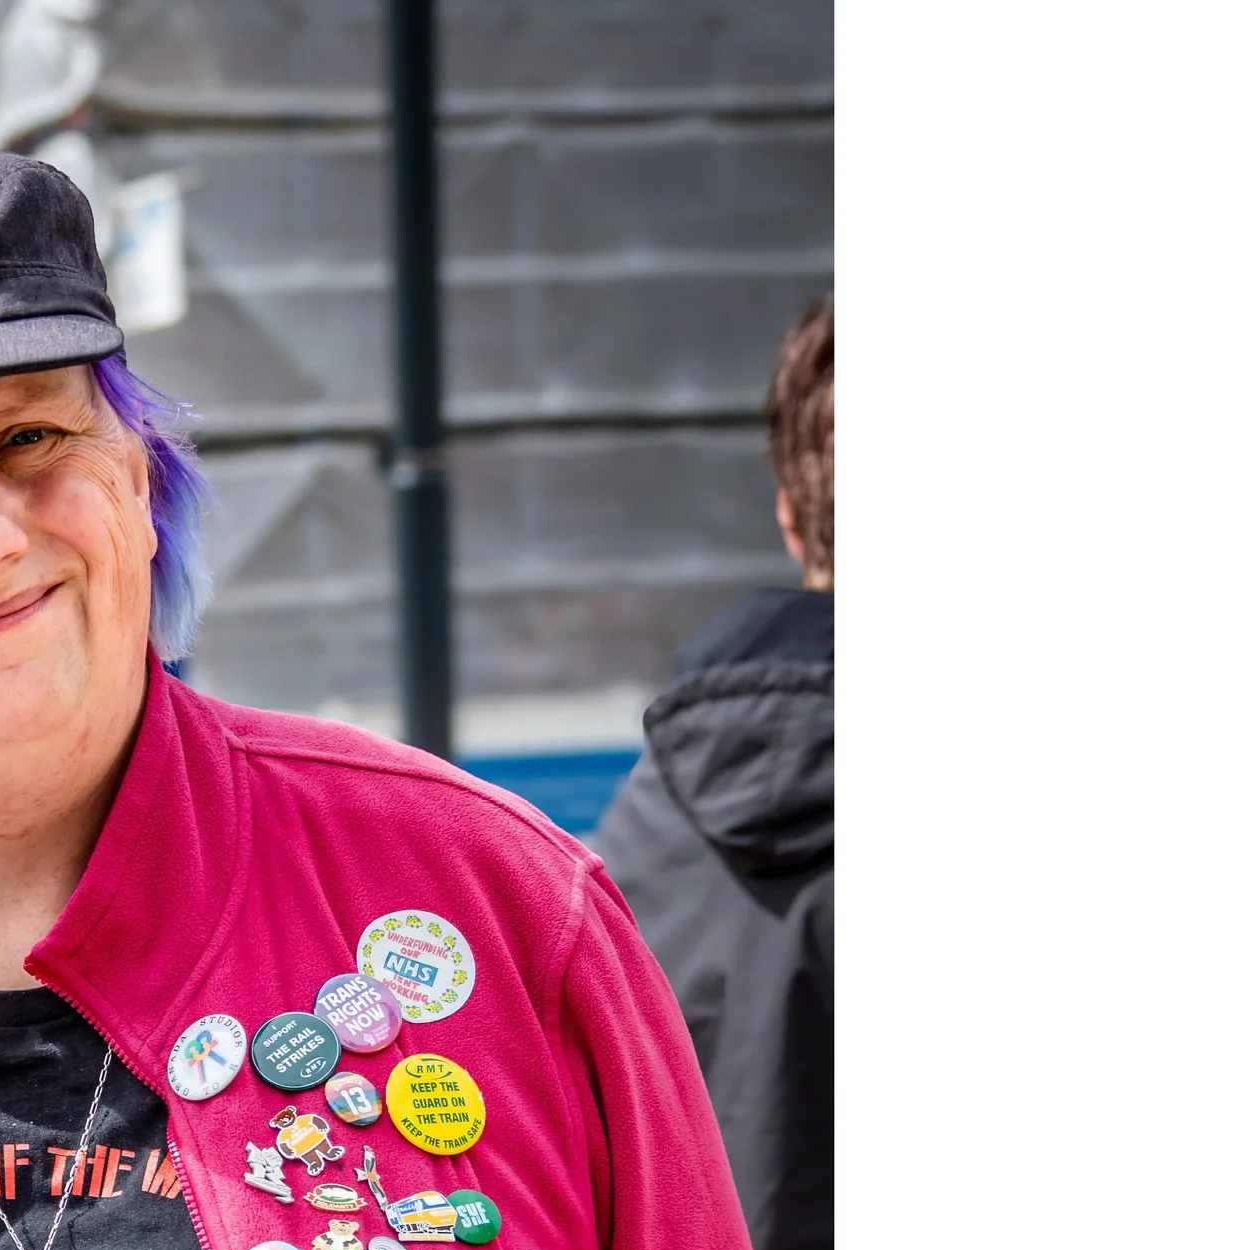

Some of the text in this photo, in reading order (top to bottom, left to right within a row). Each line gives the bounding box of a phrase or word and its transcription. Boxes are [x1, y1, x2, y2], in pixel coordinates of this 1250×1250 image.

[387, 931, 449, 960] UNDERFUNDING
[400, 947, 421, 959] OUR
[386, 954, 433, 982] NHS
[317, 976, 368, 1011] TRANS
[382, 978, 429, 1004] WORKING
[326, 987, 382, 1027] RIGHTS
[344, 1003, 385, 1036] NOW
[199, 1016, 243, 1048] STUDIOS
[262, 1020, 298, 1048] SUPPORT
[266, 1027, 317, 1063] THE RAIL
[275, 1034, 326, 1073] STRIKES
[305, 1059, 323, 1075] RMT
[203, 1063, 238, 1096] TOR
[416, 1064, 445, 1074] RMT
[340, 1086, 372, 1116] 13
[410, 1081, 460, 1094] KEEP THE
[412, 1096, 467, 1109] GUARD ON
[400, 1117, 483, 1149] KEEP THE TRAIN SAFE
[416, 1112, 470, 1125] THE TRAIN
[47, 1143, 136, 1198] THE
[456, 1201, 490, 1229] SHE
